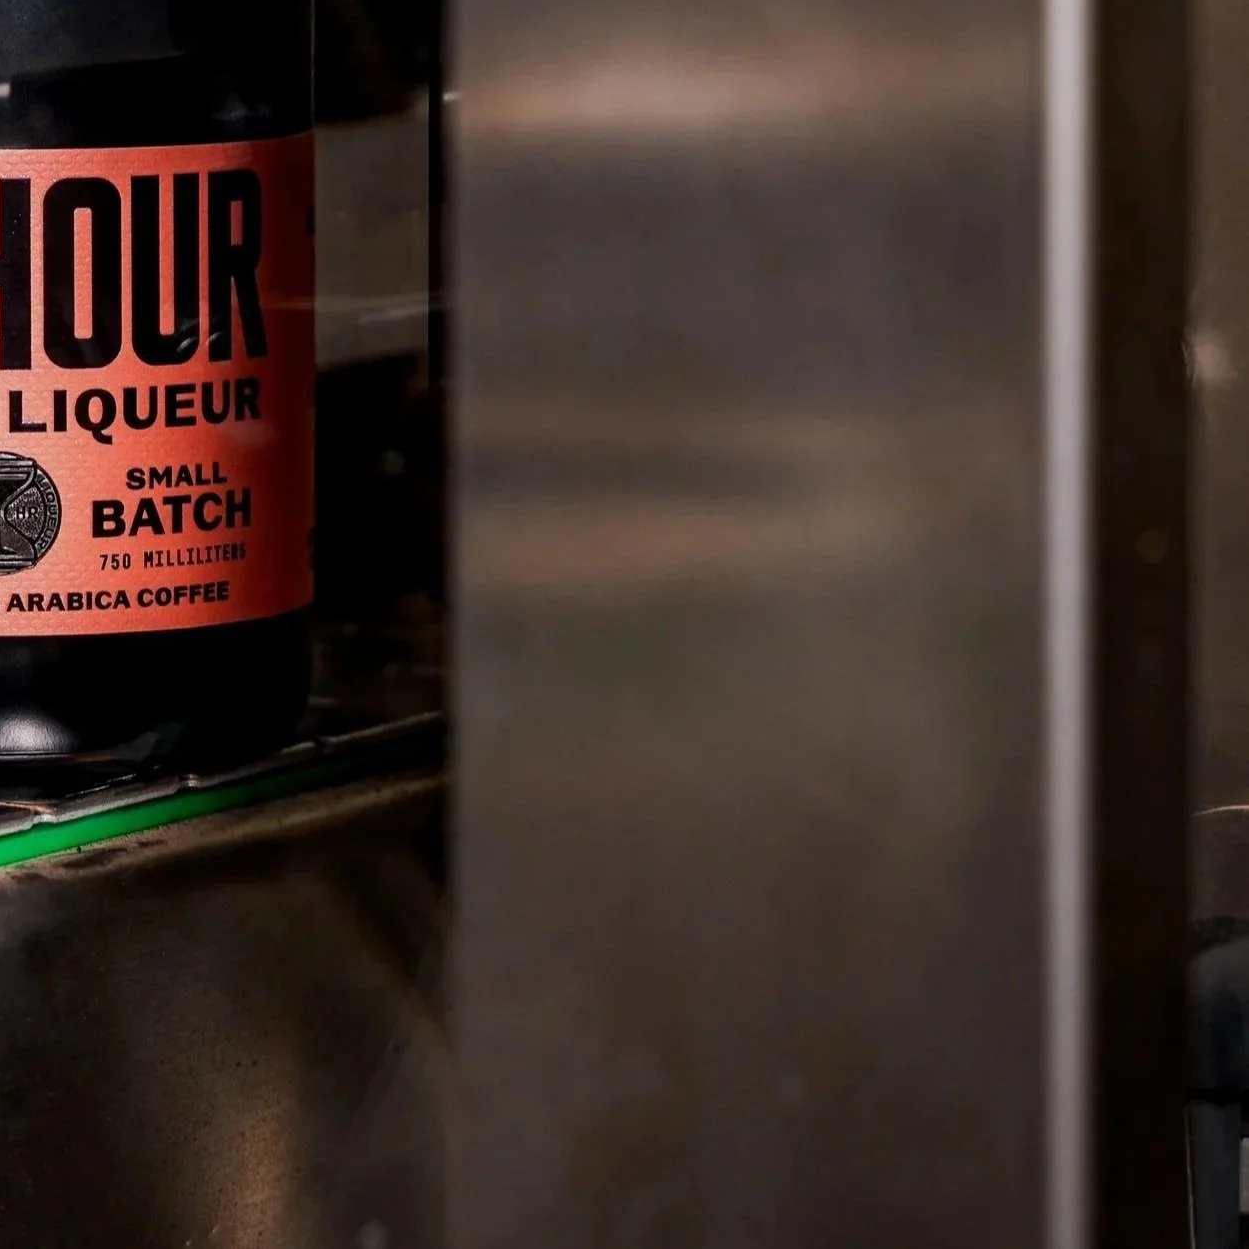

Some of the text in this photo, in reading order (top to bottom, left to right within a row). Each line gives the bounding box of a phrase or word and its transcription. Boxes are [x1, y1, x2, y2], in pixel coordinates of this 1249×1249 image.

[8, 378, 261, 445] LIQUEUR
[126, 461, 228, 490] SMALL
[16, 506, 39, 521] HR
[37, 475, 57, 550] LIQUEUR
[92, 487, 252, 538] BATCH
[99, 542, 247, 571] 750 MILLILITERS
[6, 590, 131, 613] ARABICA
[136, 580, 231, 608] COFFEE
